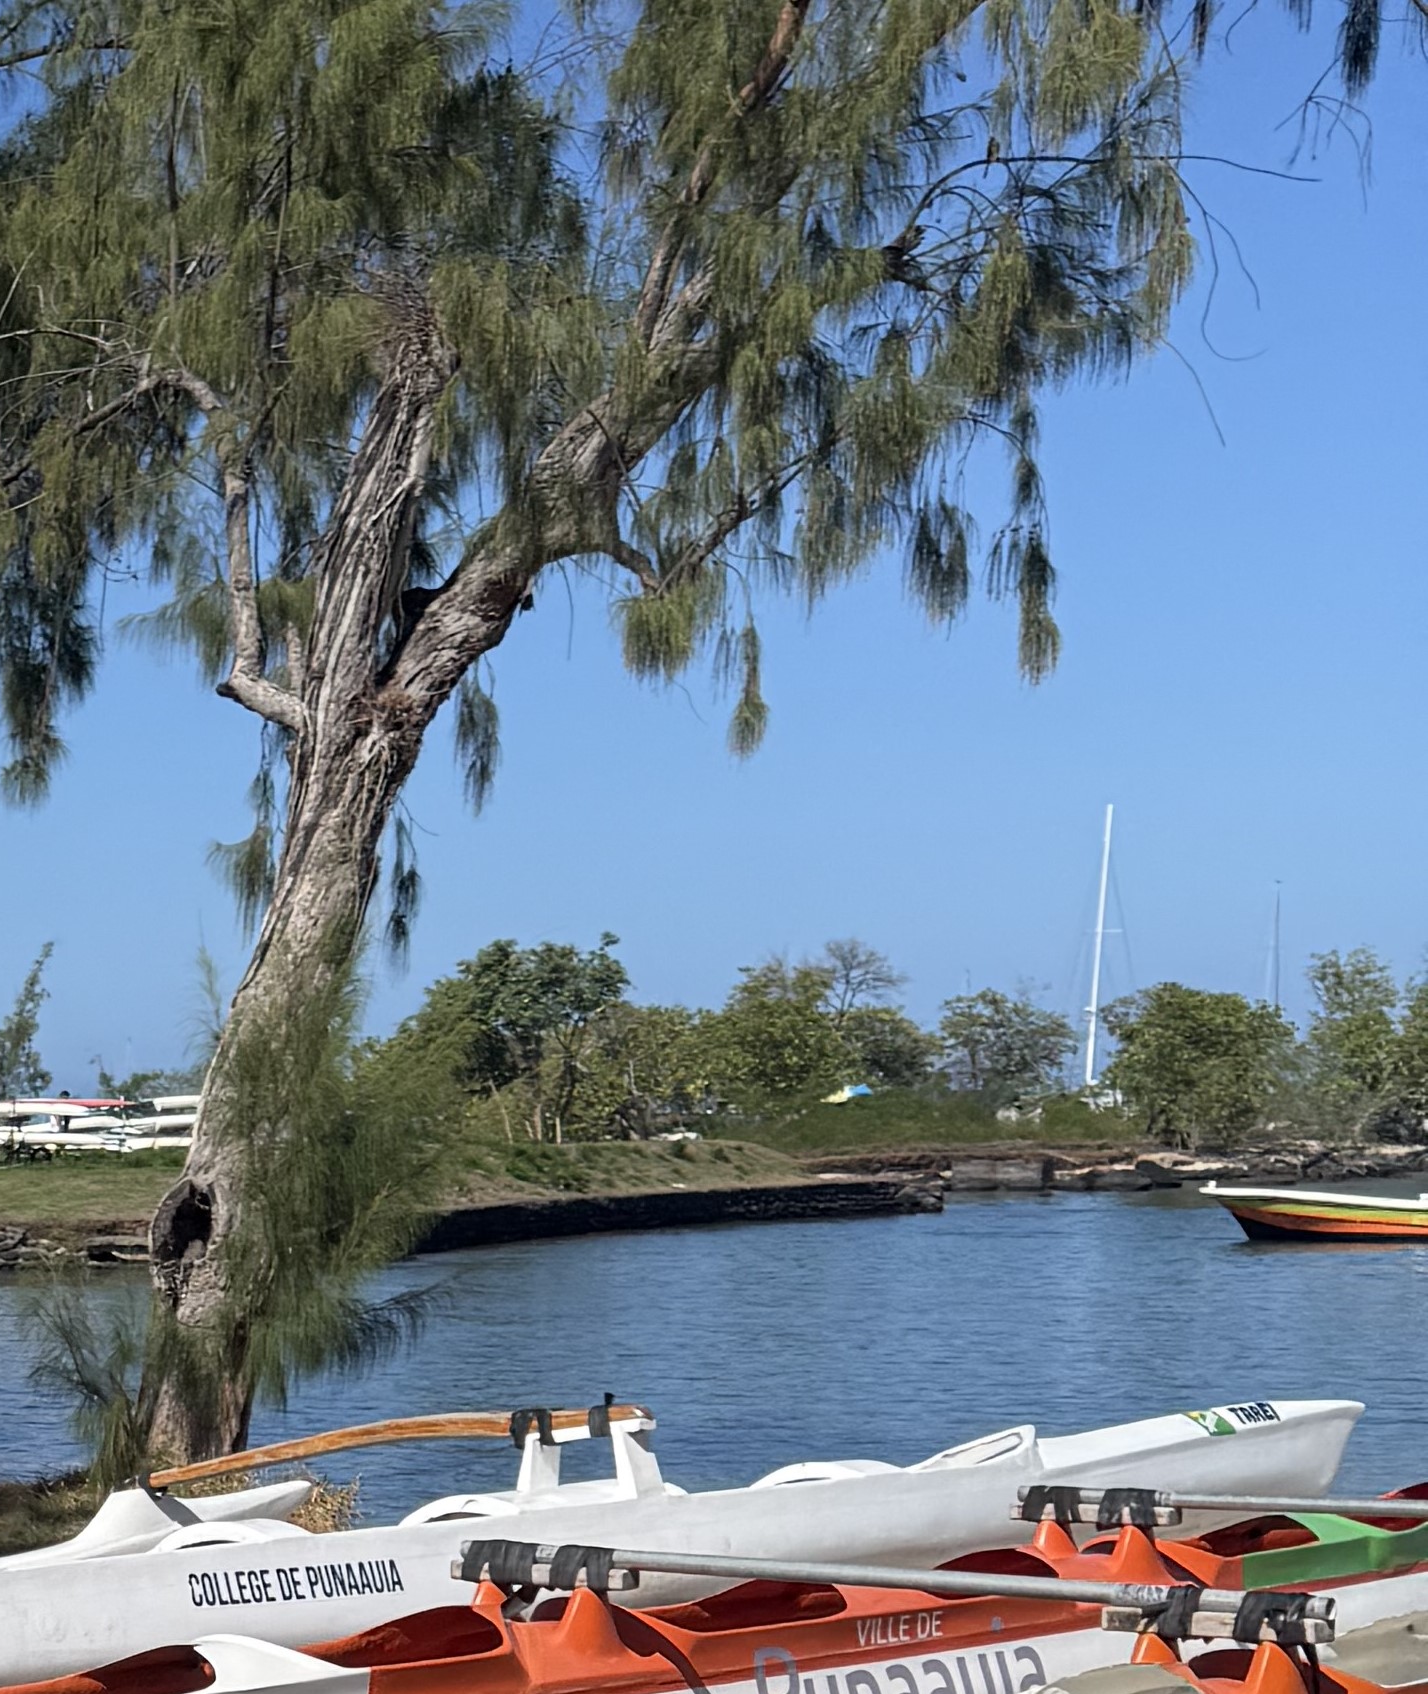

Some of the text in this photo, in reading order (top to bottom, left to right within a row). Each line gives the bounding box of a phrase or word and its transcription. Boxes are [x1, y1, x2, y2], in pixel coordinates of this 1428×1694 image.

[188, 1559, 404, 1607] COLLEGE DE PUNAAUIA
[856, 1611, 943, 1648] VILLE DE
